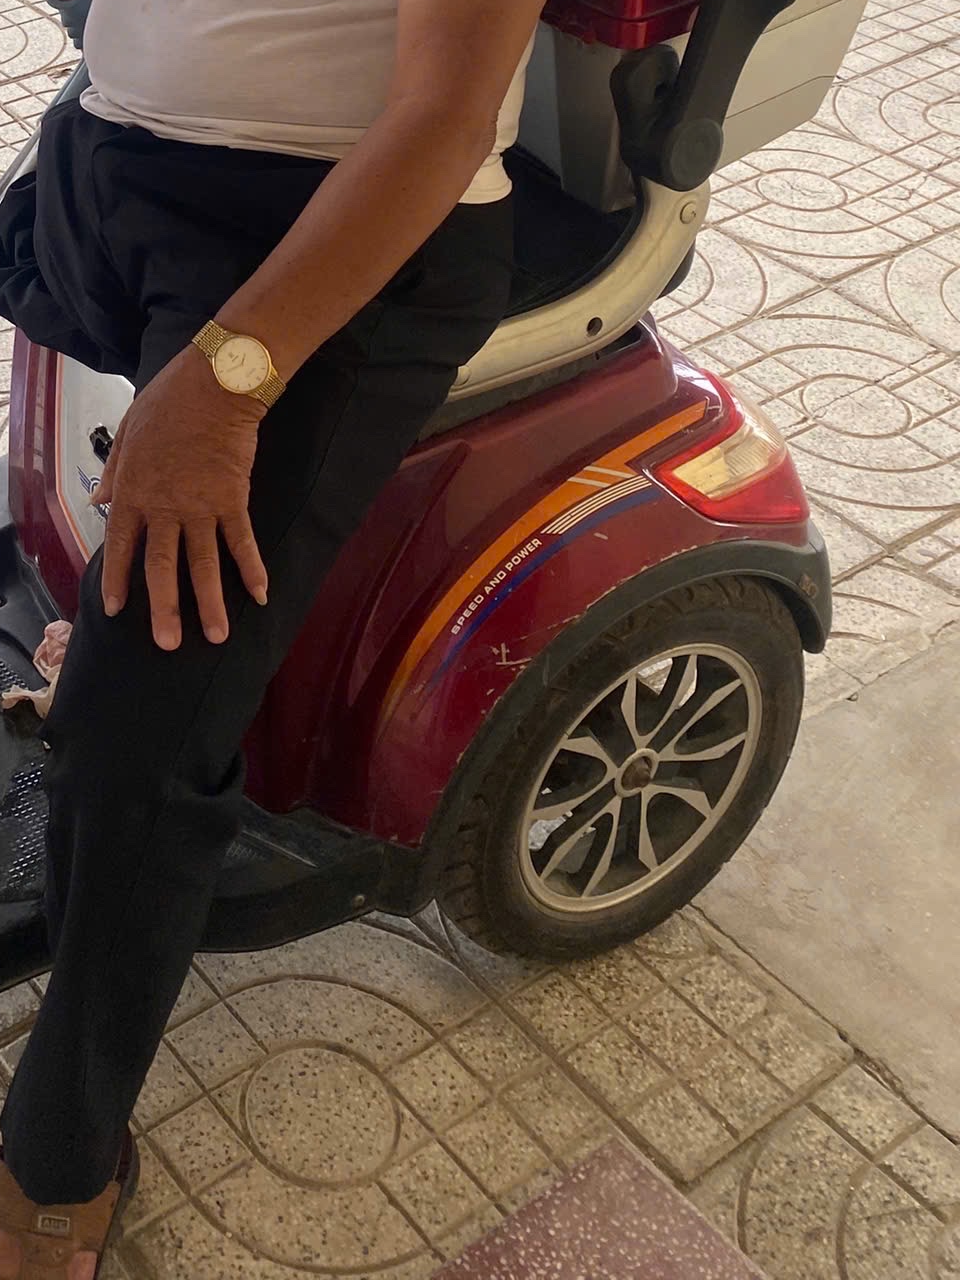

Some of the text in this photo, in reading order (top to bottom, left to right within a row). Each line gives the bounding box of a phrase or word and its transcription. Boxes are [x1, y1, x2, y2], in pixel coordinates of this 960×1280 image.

[451, 538, 542, 635] SPEED AND POWER
